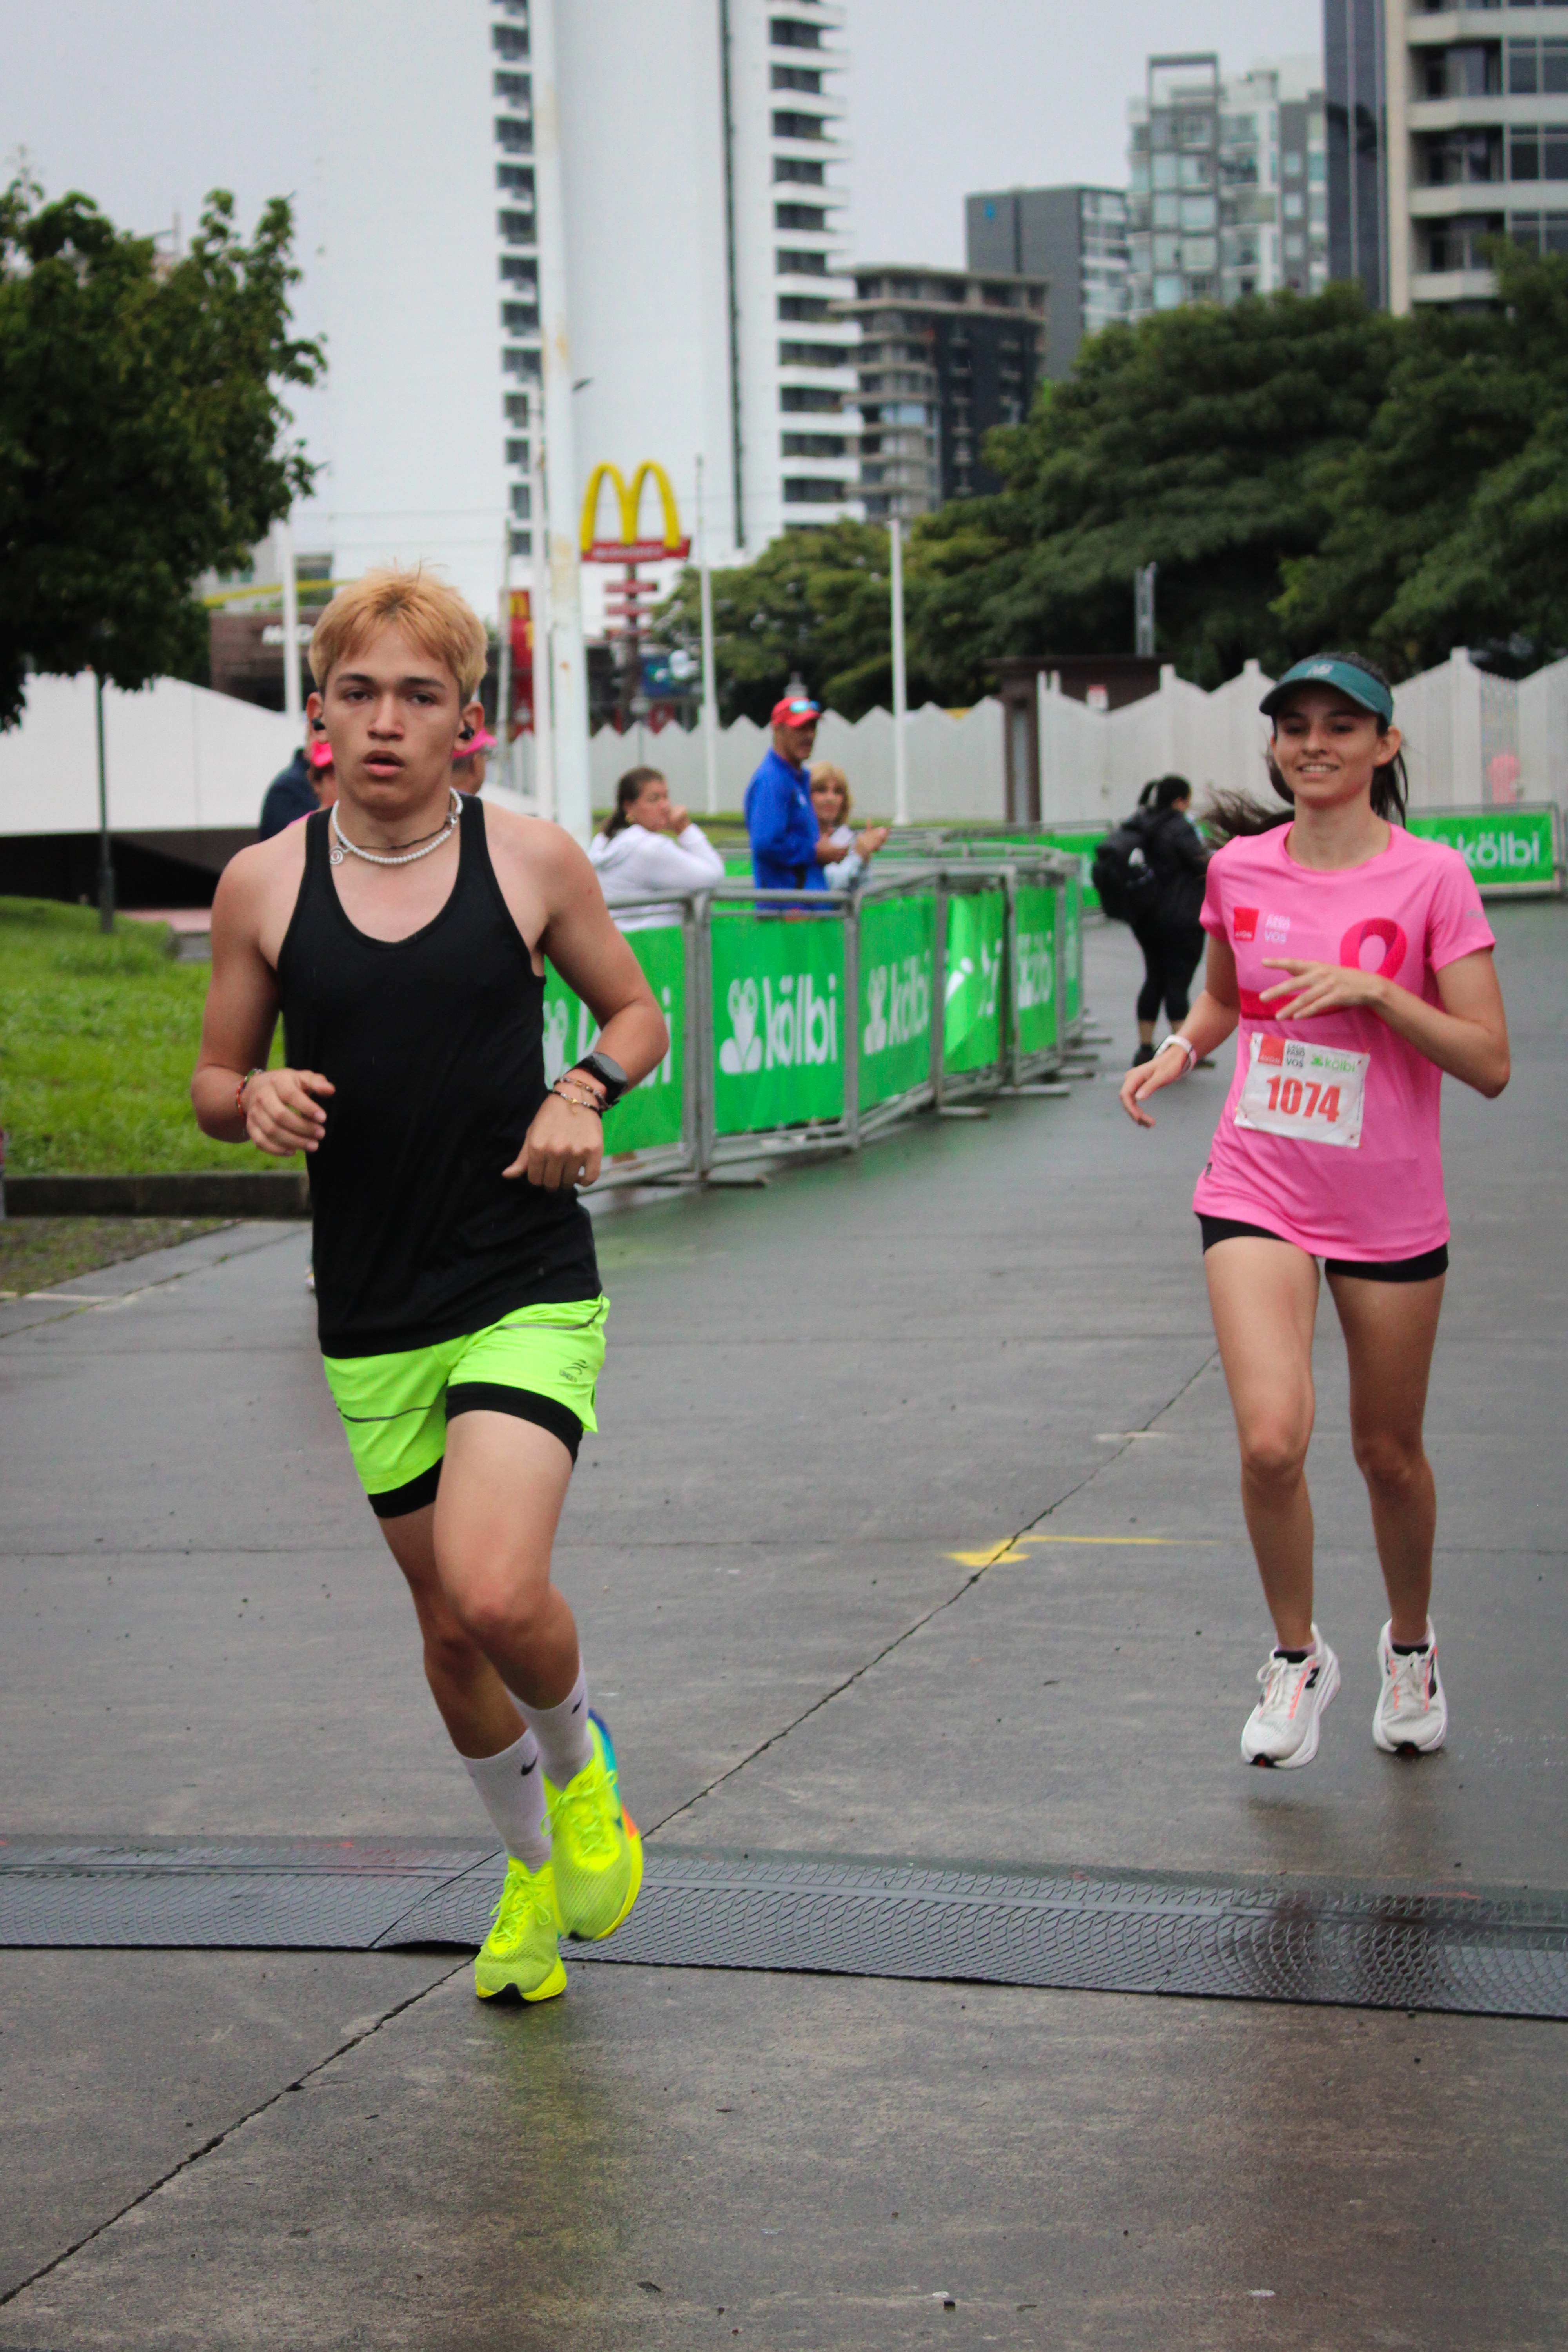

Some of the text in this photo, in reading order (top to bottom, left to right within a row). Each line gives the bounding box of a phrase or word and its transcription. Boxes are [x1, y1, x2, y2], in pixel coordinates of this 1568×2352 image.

[1457, 831, 1540, 869] kölbi
[763, 973, 837, 1071] kölbi
[1287, 1058, 1303, 1067] VOS
[1267, 1075, 1341, 1122] 1074
